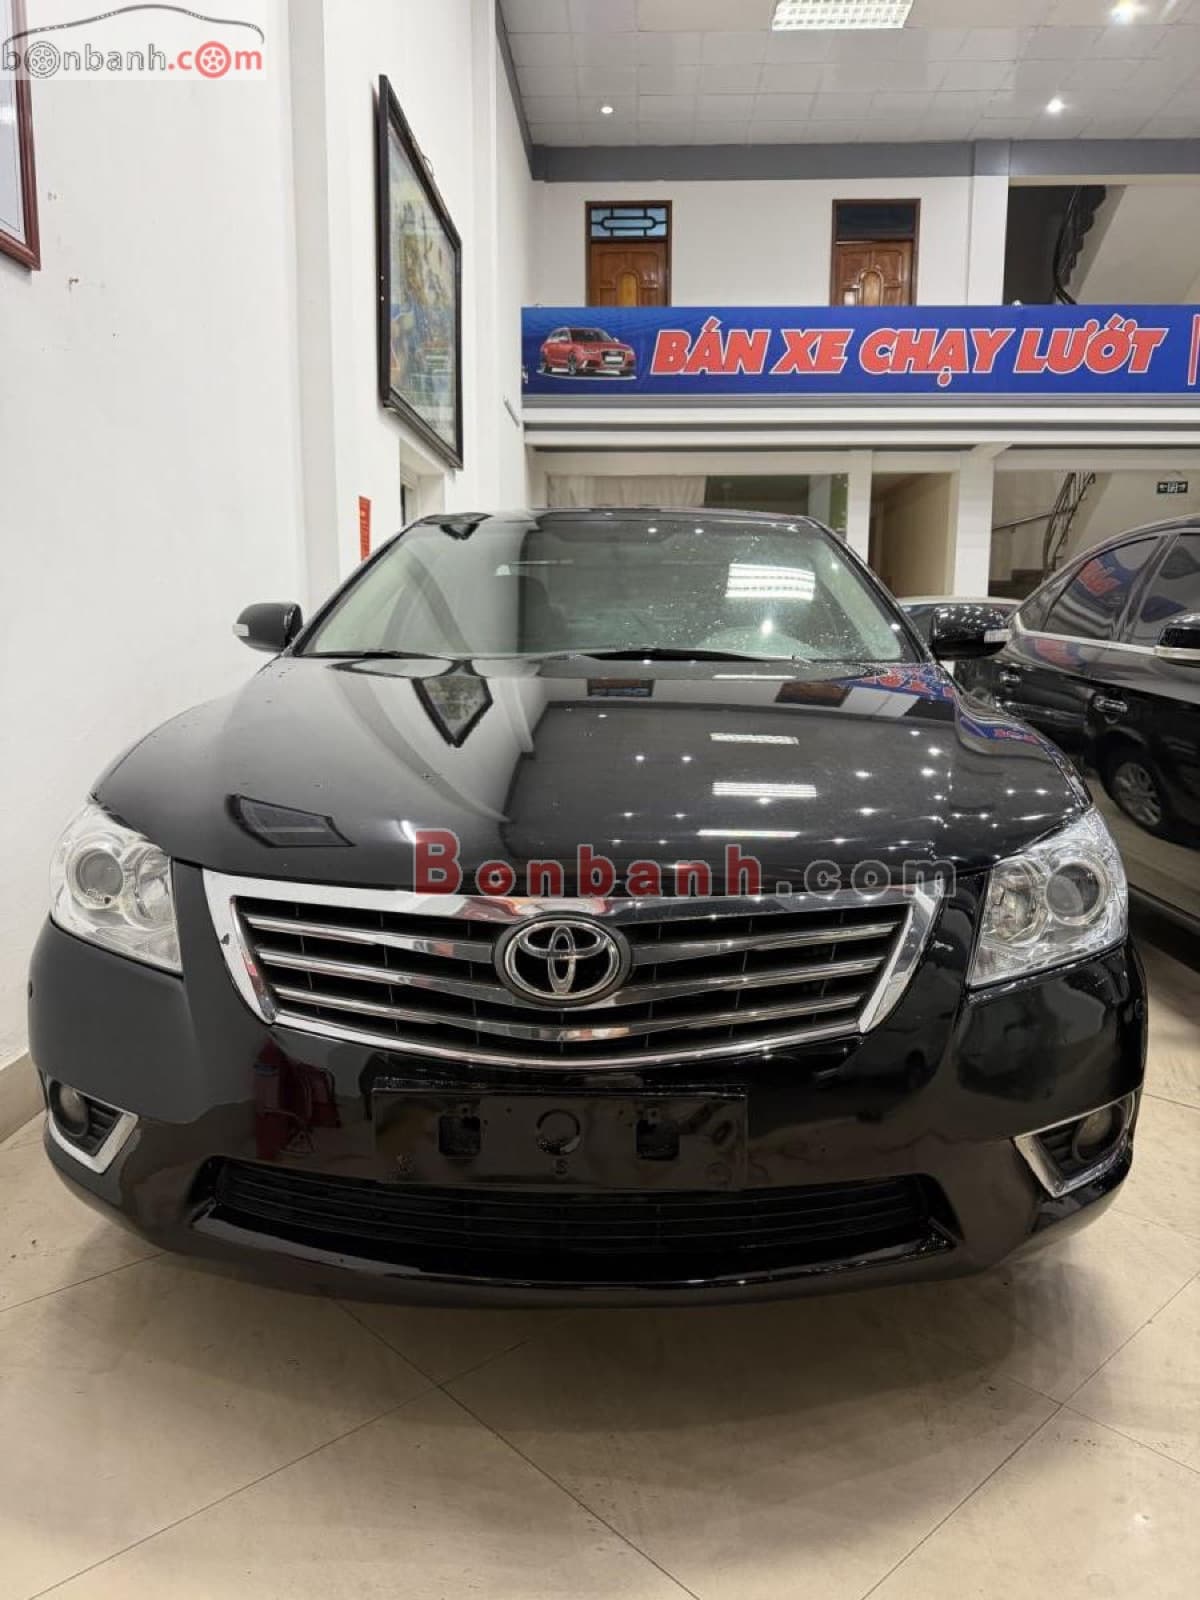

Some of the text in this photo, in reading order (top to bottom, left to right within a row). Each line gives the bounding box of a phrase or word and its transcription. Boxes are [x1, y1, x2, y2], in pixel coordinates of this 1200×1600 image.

[650, 315, 771, 375] BÁN
[769, 328, 854, 375] XE
[859, 328, 1016, 387] CHẠY
[1012, 313, 1169, 375] LƯỚT
